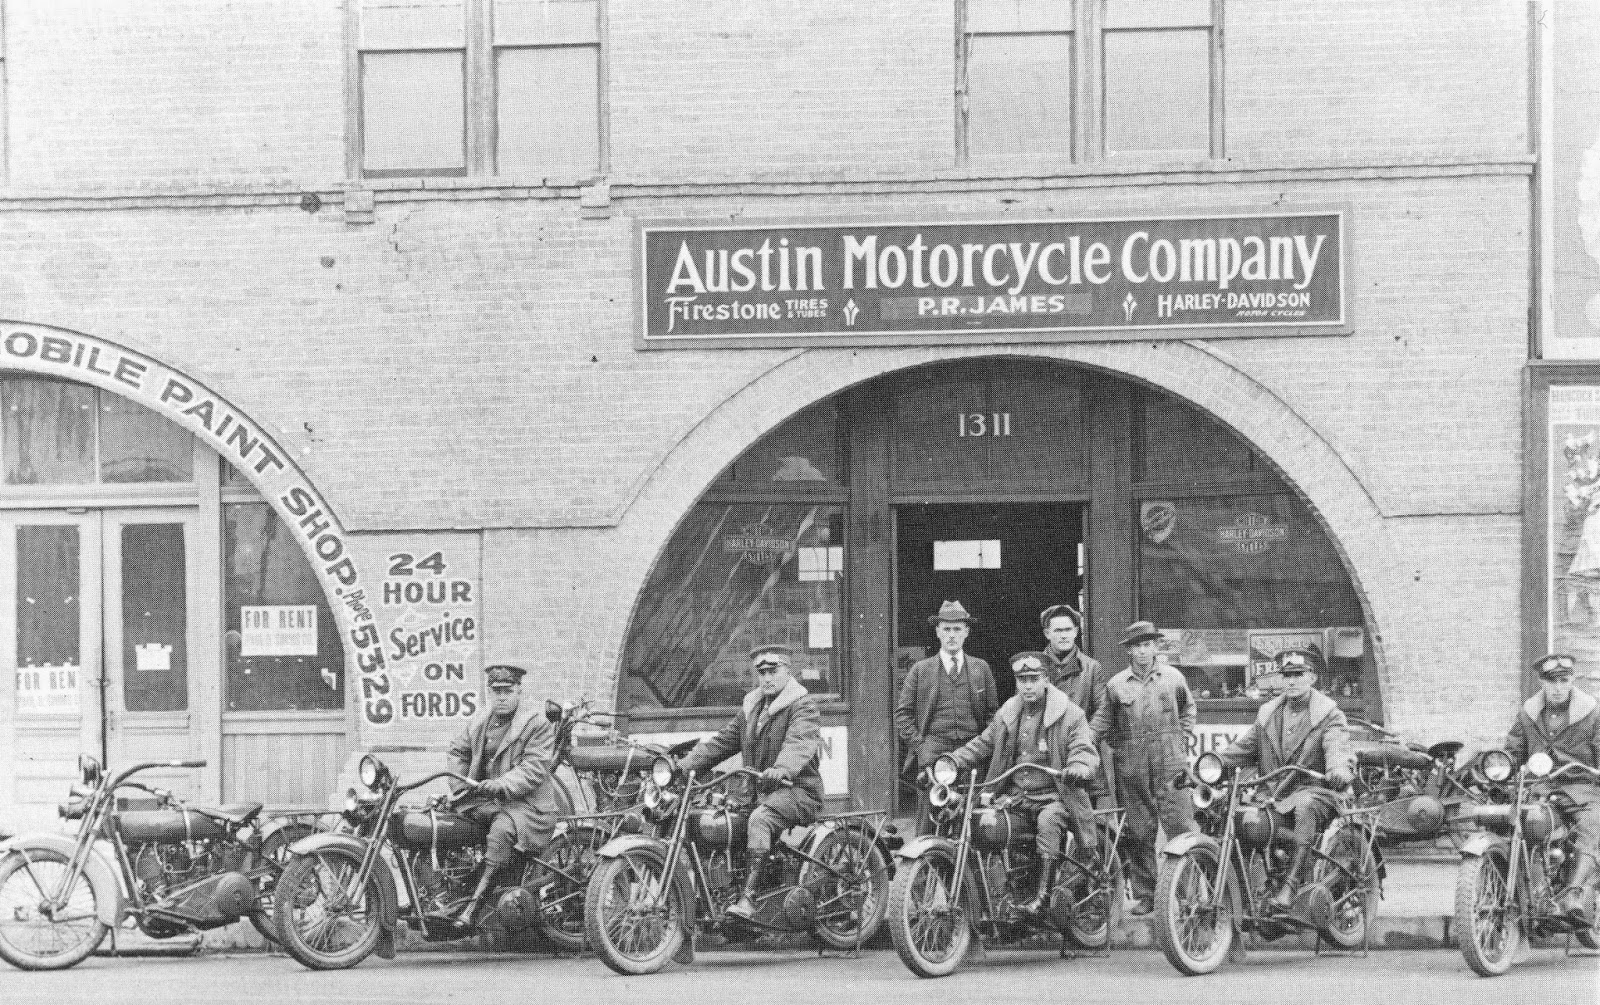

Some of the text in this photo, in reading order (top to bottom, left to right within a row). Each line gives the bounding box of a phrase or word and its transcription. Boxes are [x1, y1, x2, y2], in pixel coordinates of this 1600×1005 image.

[666, 231, 1327, 295] Austin Motorcycle Company
[664, 295, 829, 333] Firestone TIRES
[797, 309, 827, 318] TUBES
[160, 378, 285, 477] PAINT
[958, 412, 1011, 437] 1311
[389, 551, 447, 576] 24
[383, 580, 473, 604] HOUR
[245, 609, 314, 629] FOR RENT
[389, 611, 476, 661] Service
[15, 671, 40, 691] FOR
[350, 622, 393, 724] 5329
[424, 663, 464, 680] ON
[401, 692, 477, 717] FORDS
